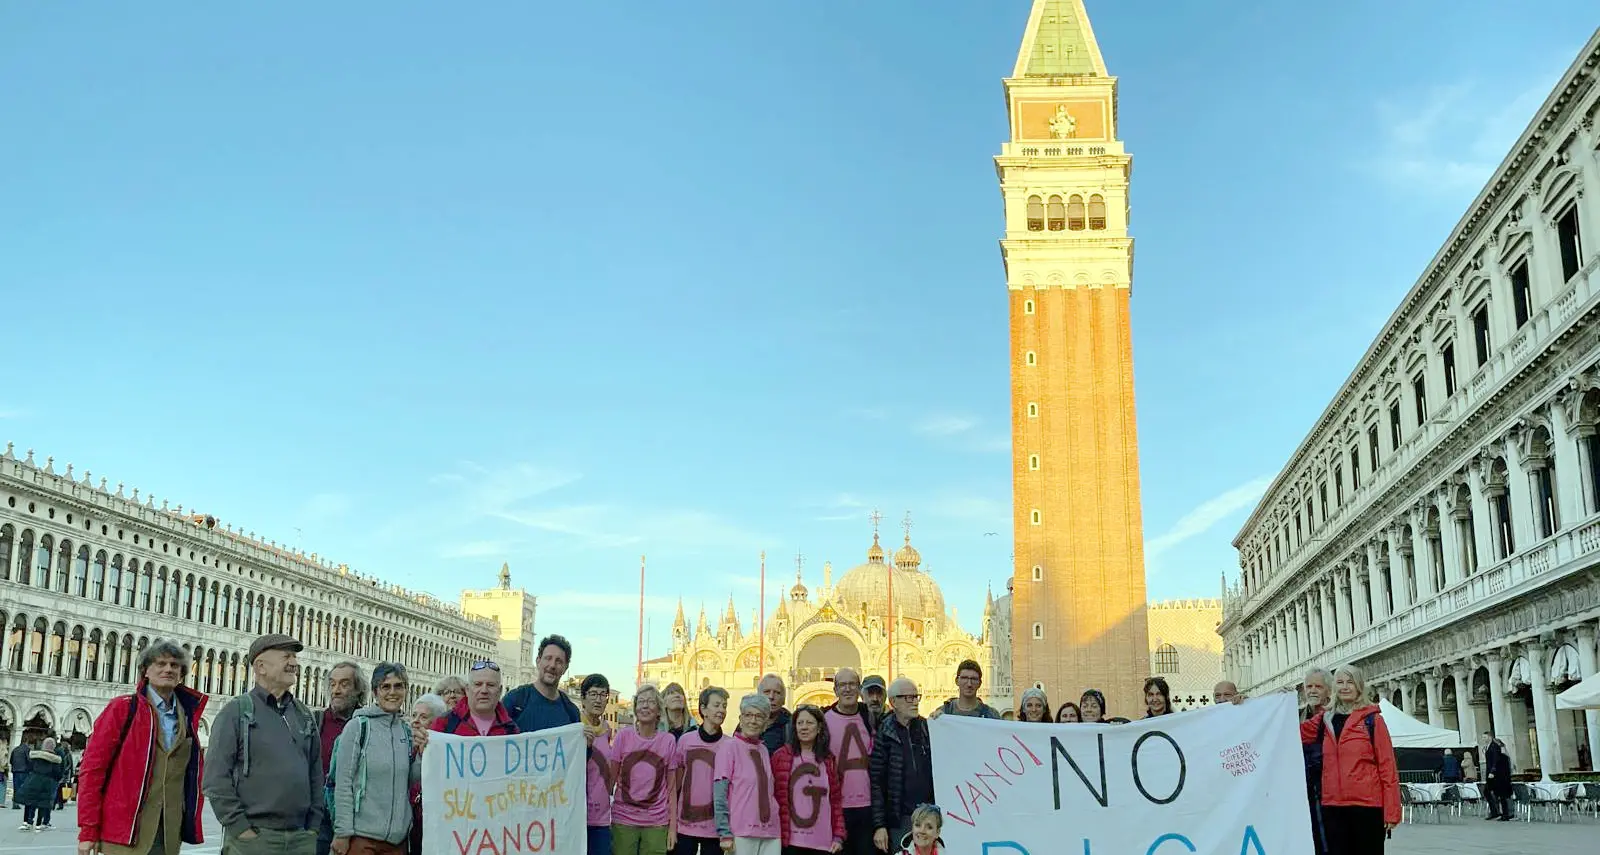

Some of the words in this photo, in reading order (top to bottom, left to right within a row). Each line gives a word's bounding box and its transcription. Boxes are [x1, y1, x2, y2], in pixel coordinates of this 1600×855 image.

[446, 742, 487, 779] NO
[504, 736, 566, 775] DIGA
[1050, 730, 1186, 810] NO
[1221, 751, 1261, 770] TORRENTE
[1231, 763, 1257, 777] VANOI
[443, 787, 476, 821] SUL
[484, 779, 568, 818] TORRENTE
[946, 734, 1043, 827] VANOI
[452, 818, 556, 855] VANOI
